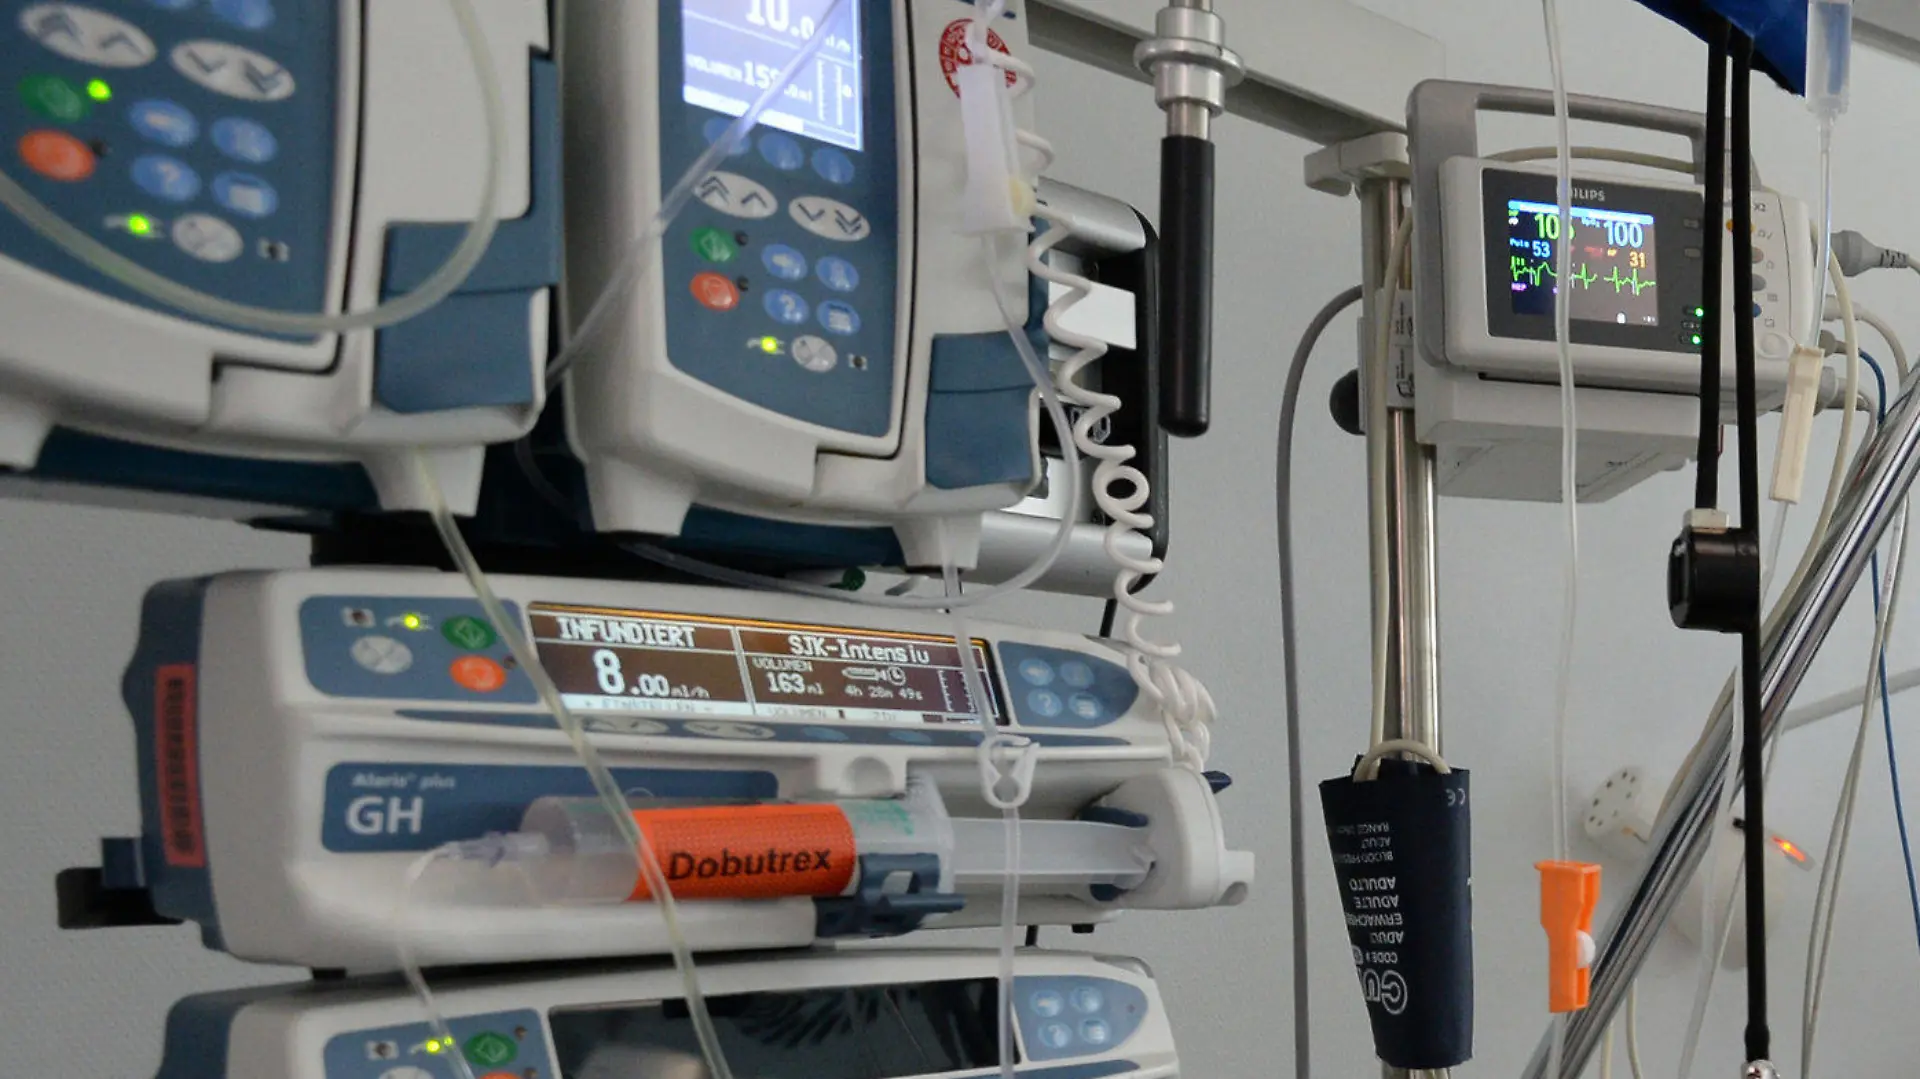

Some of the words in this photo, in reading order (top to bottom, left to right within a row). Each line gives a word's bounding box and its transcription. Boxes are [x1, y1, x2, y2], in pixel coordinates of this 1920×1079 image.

[1571, 187, 1605, 202] ILIPS
[1603, 219, 1644, 248] 100
[1531, 239, 1552, 258] 53
[1628, 250, 1647, 269] 31
[557, 616, 696, 647] INFUNDIERT
[345, 795, 424, 836] GH
[668, 847, 832, 881] Dobutrex
